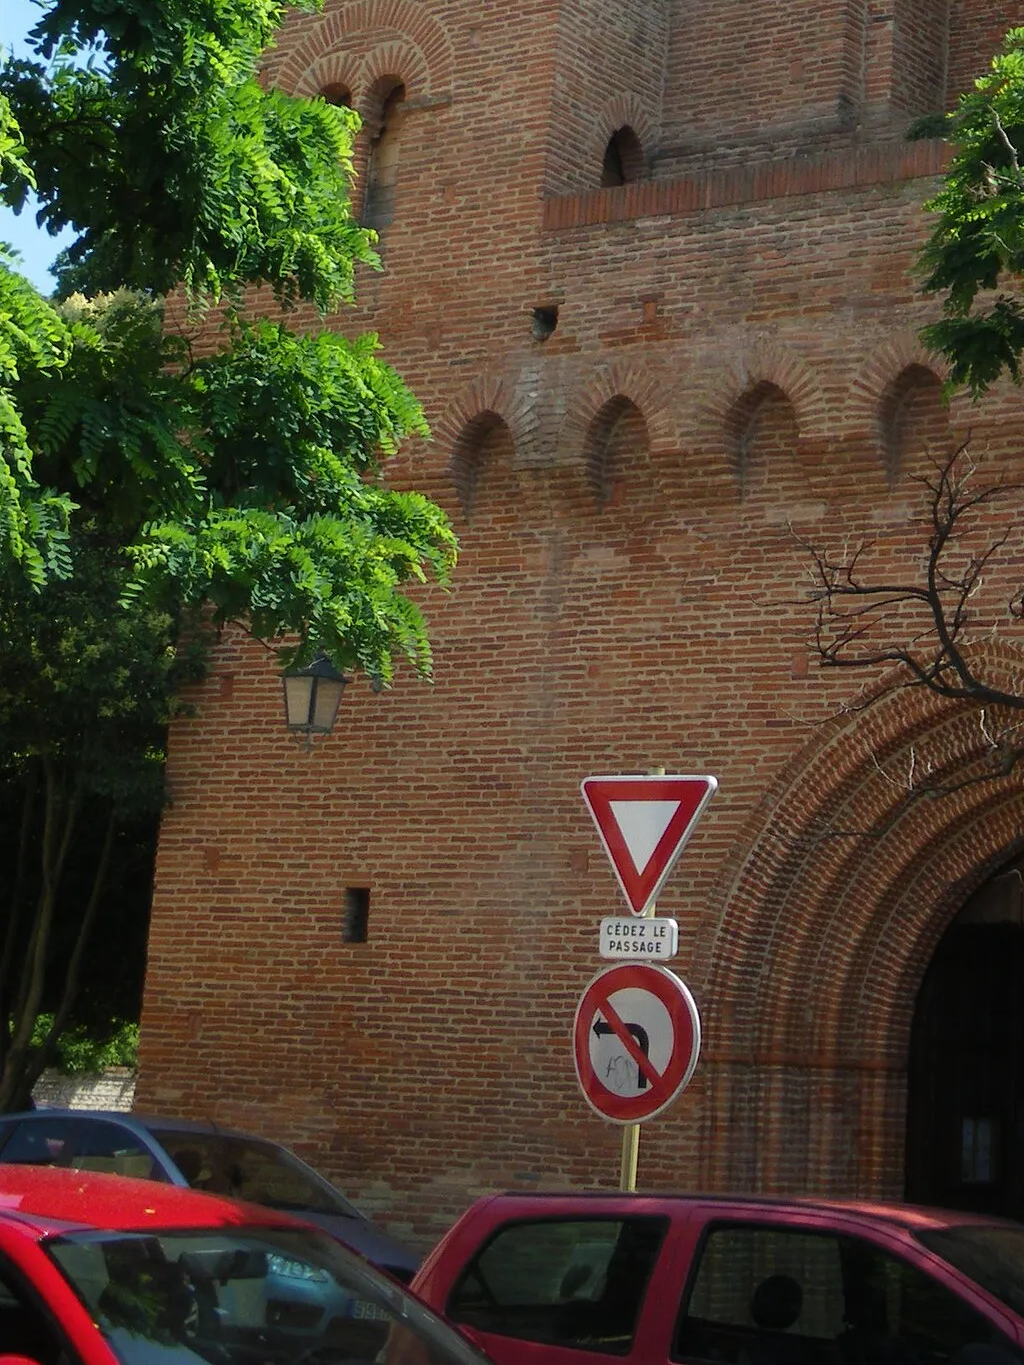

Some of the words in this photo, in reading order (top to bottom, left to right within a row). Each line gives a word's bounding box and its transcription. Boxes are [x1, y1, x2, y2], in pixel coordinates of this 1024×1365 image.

[606, 922, 646, 937] CÉDEZ
[653, 926, 666, 937] LE
[609, 940, 662, 953] PASSAGE
